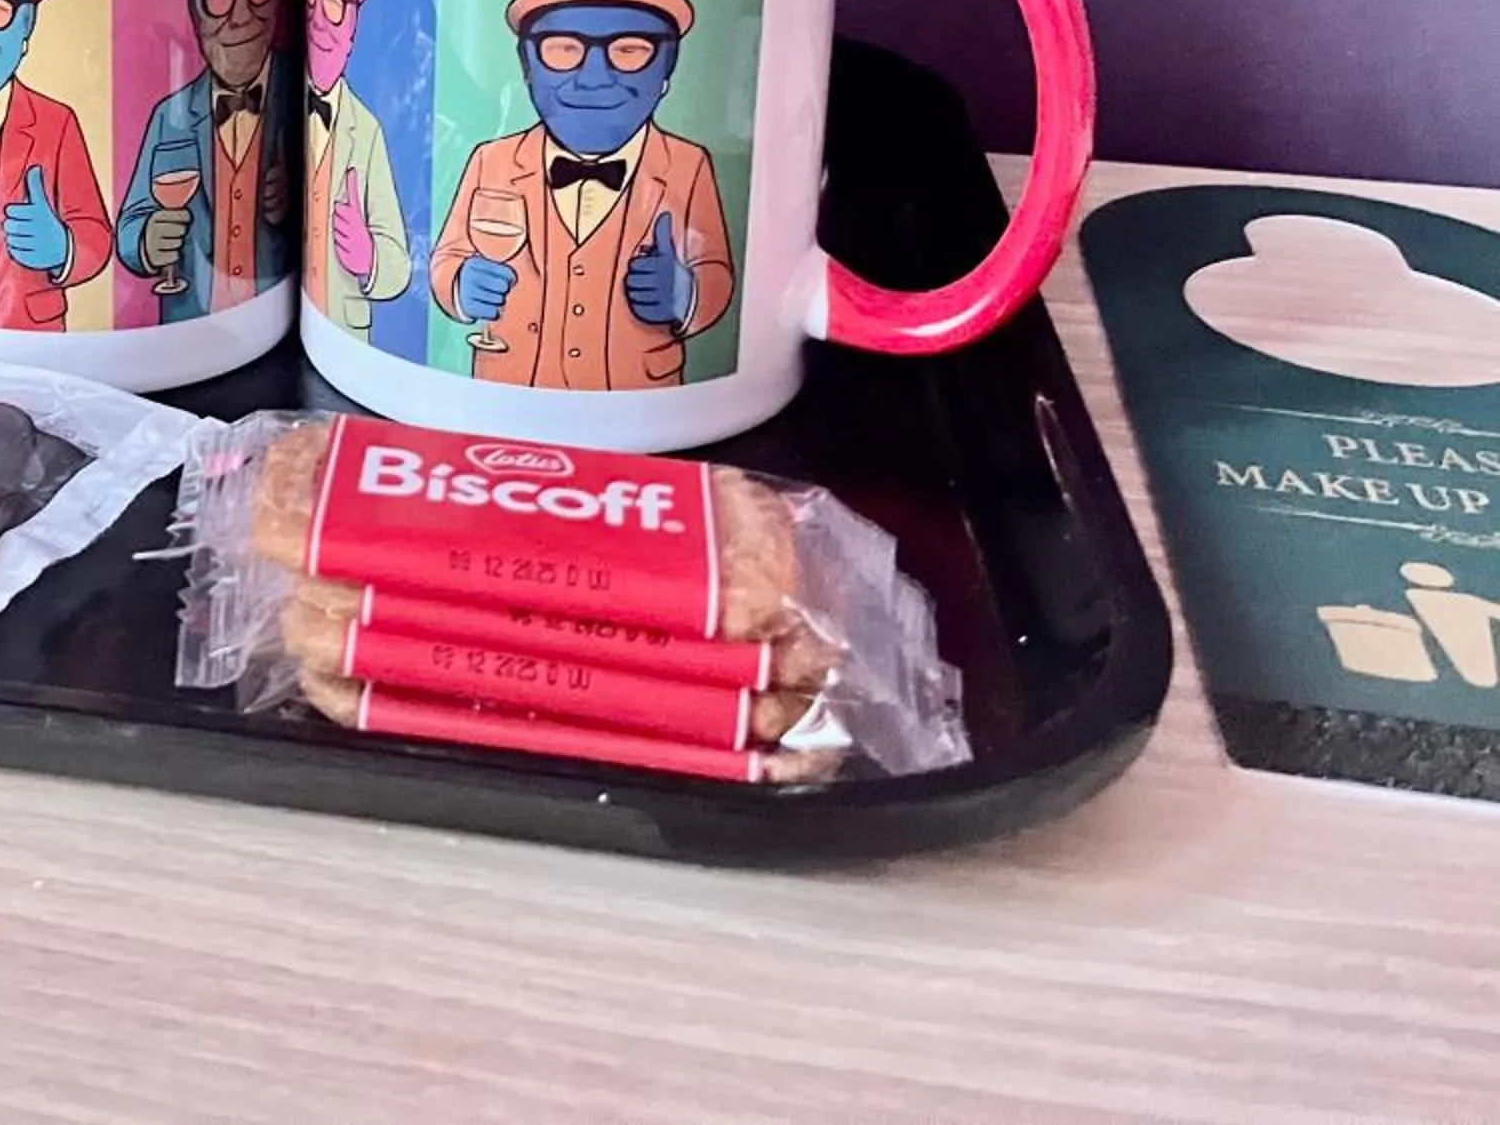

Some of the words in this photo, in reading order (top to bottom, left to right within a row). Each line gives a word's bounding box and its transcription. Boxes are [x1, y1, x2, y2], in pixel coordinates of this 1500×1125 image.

[357, 445, 676, 533] Biscoff
[1213, 460, 1400, 506] MAKE
[1405, 481, 1490, 515] UP
[485, 554, 503, 578] 12
[467, 650, 486, 674] 12
